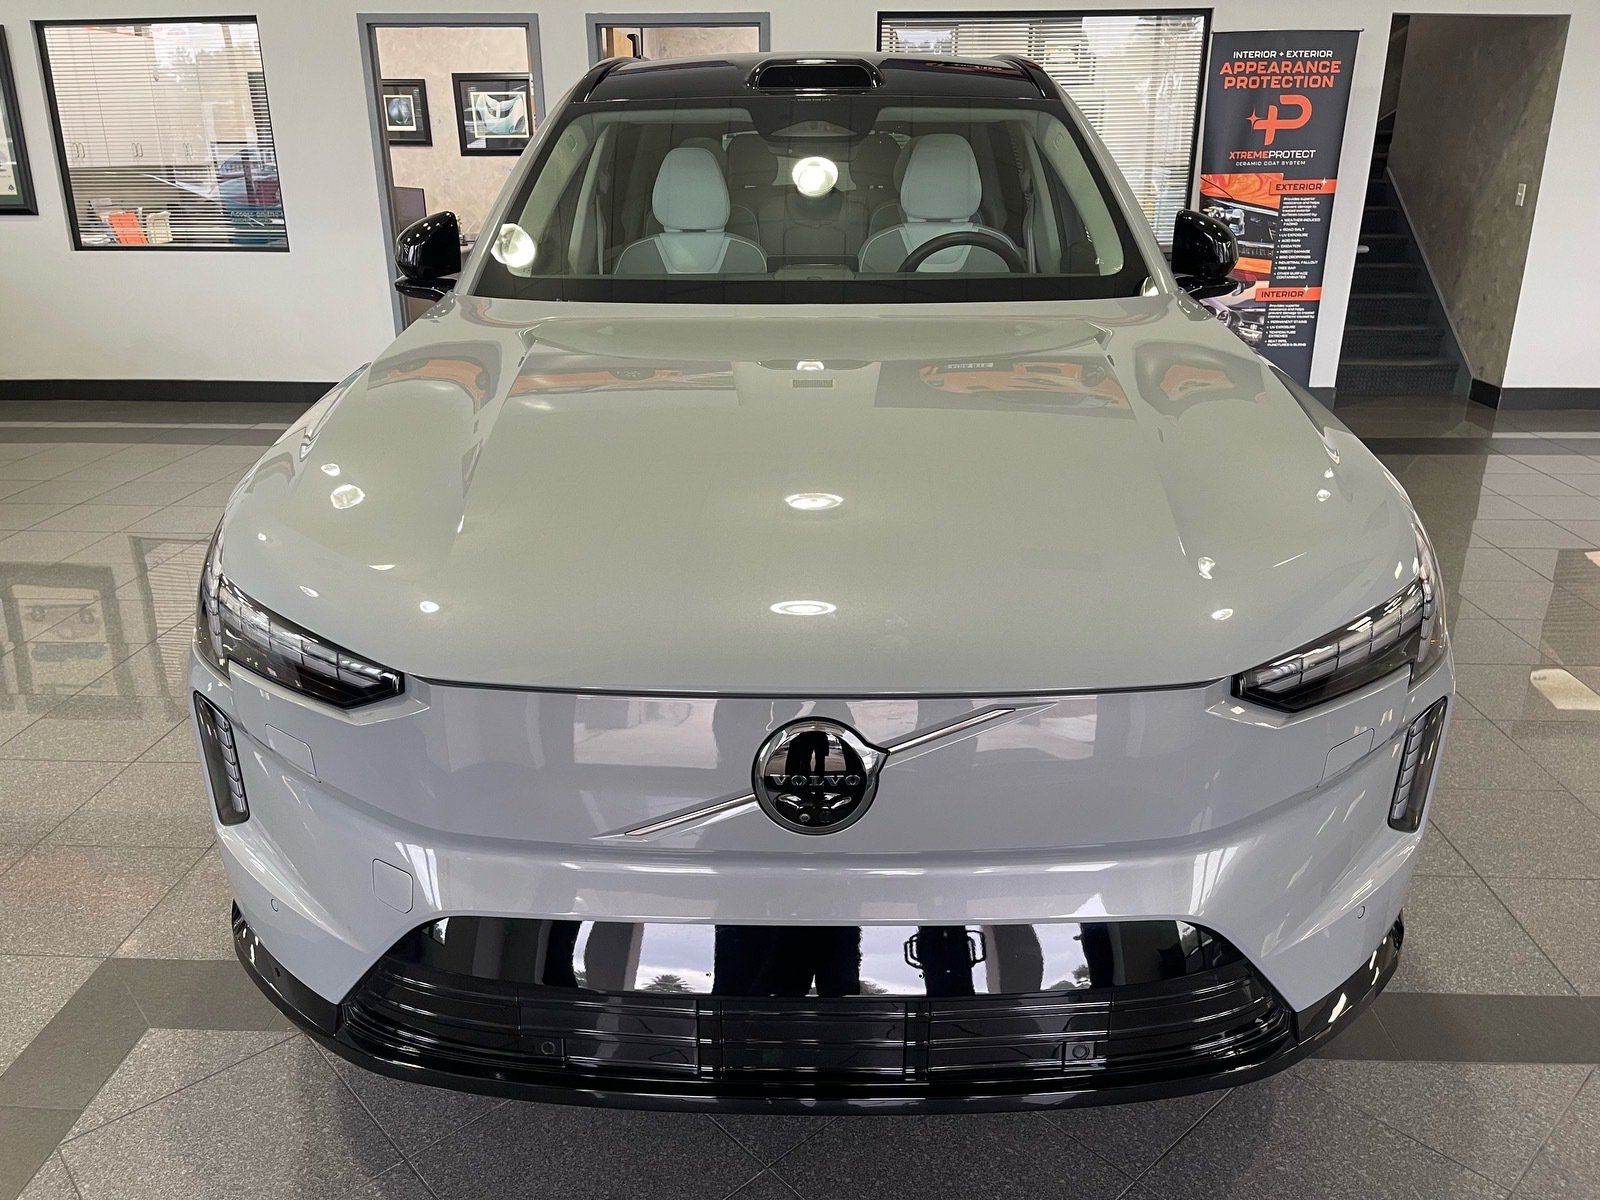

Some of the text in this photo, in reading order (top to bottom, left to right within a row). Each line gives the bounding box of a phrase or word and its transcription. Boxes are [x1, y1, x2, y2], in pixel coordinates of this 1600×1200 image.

[1233, 50, 1277, 59] INTERIOR
[1286, 50, 1333, 59] EXTERIOR
[1220, 61, 1342, 75] APPEARANCE
[1224, 75, 1335, 89] PROTECTION
[1229, 150, 1317, 159] XTREMEPROTECT
[770, 774, 860, 786] VOLVO
